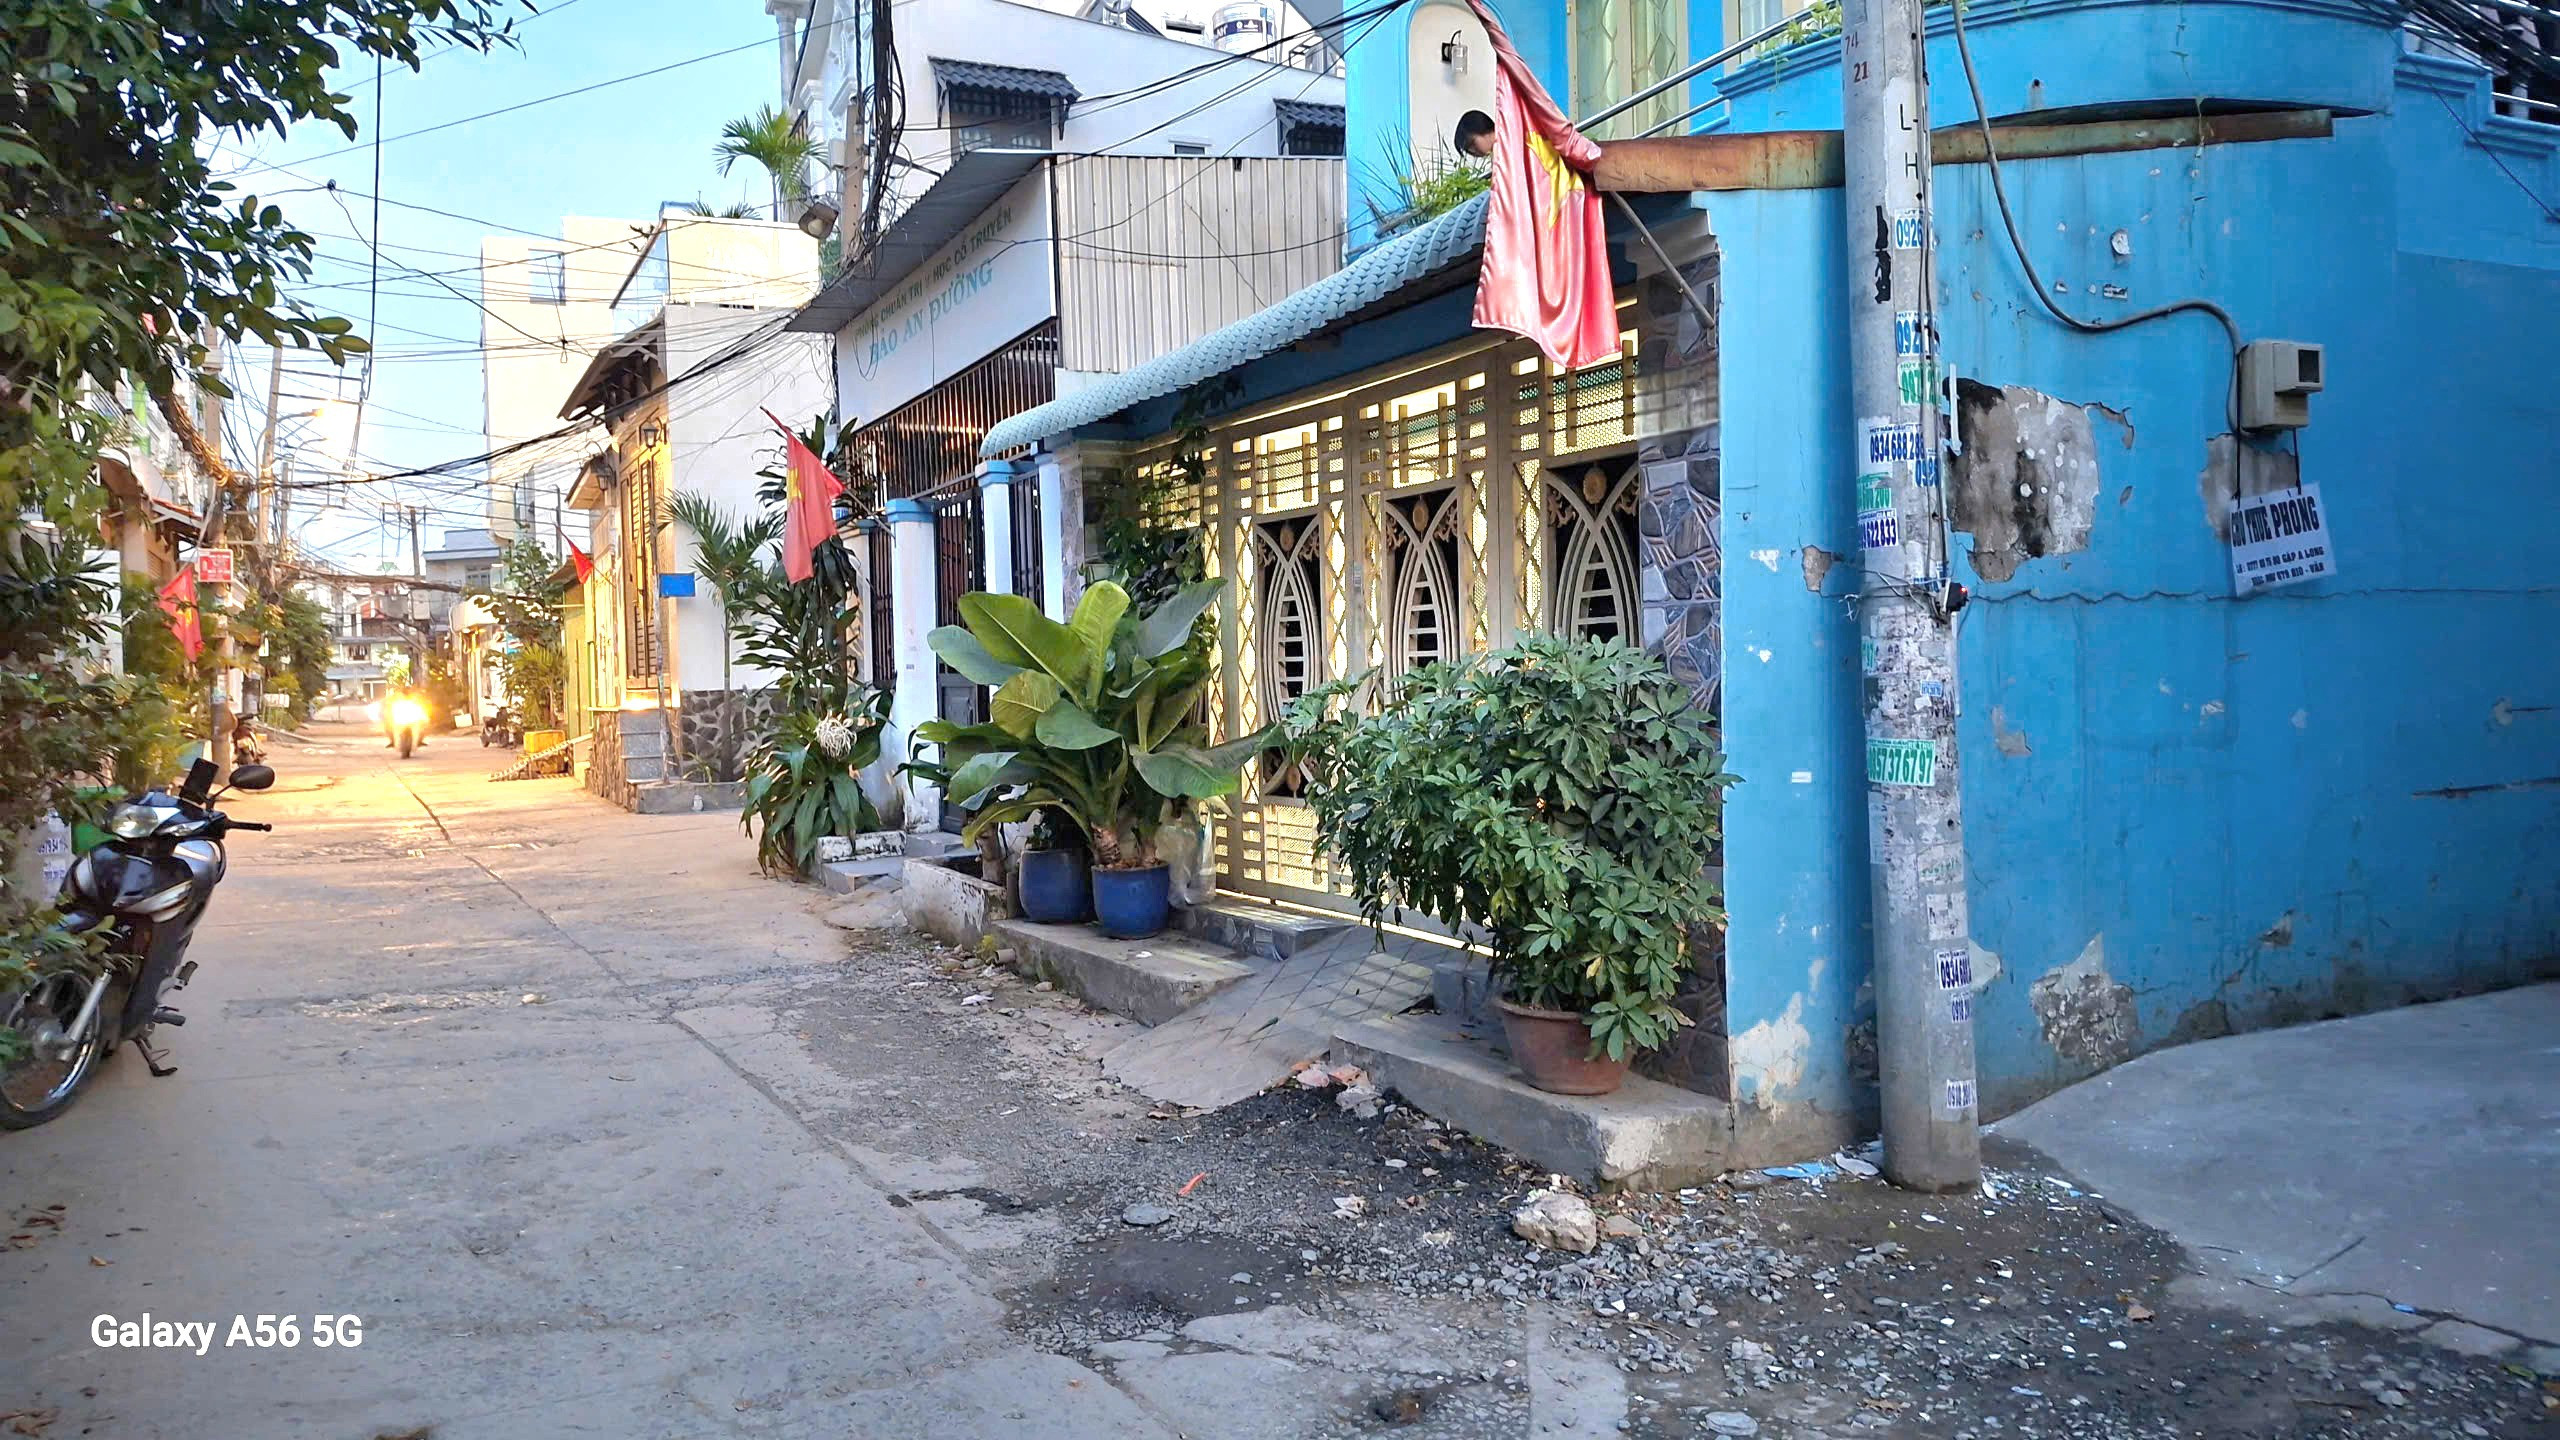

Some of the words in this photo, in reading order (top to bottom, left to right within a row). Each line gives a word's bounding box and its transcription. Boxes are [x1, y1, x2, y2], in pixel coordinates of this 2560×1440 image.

[1853, 61, 1869, 83] 21
[904, 309, 924, 342] AN
[2270, 490, 2320, 538] PHÒNG
